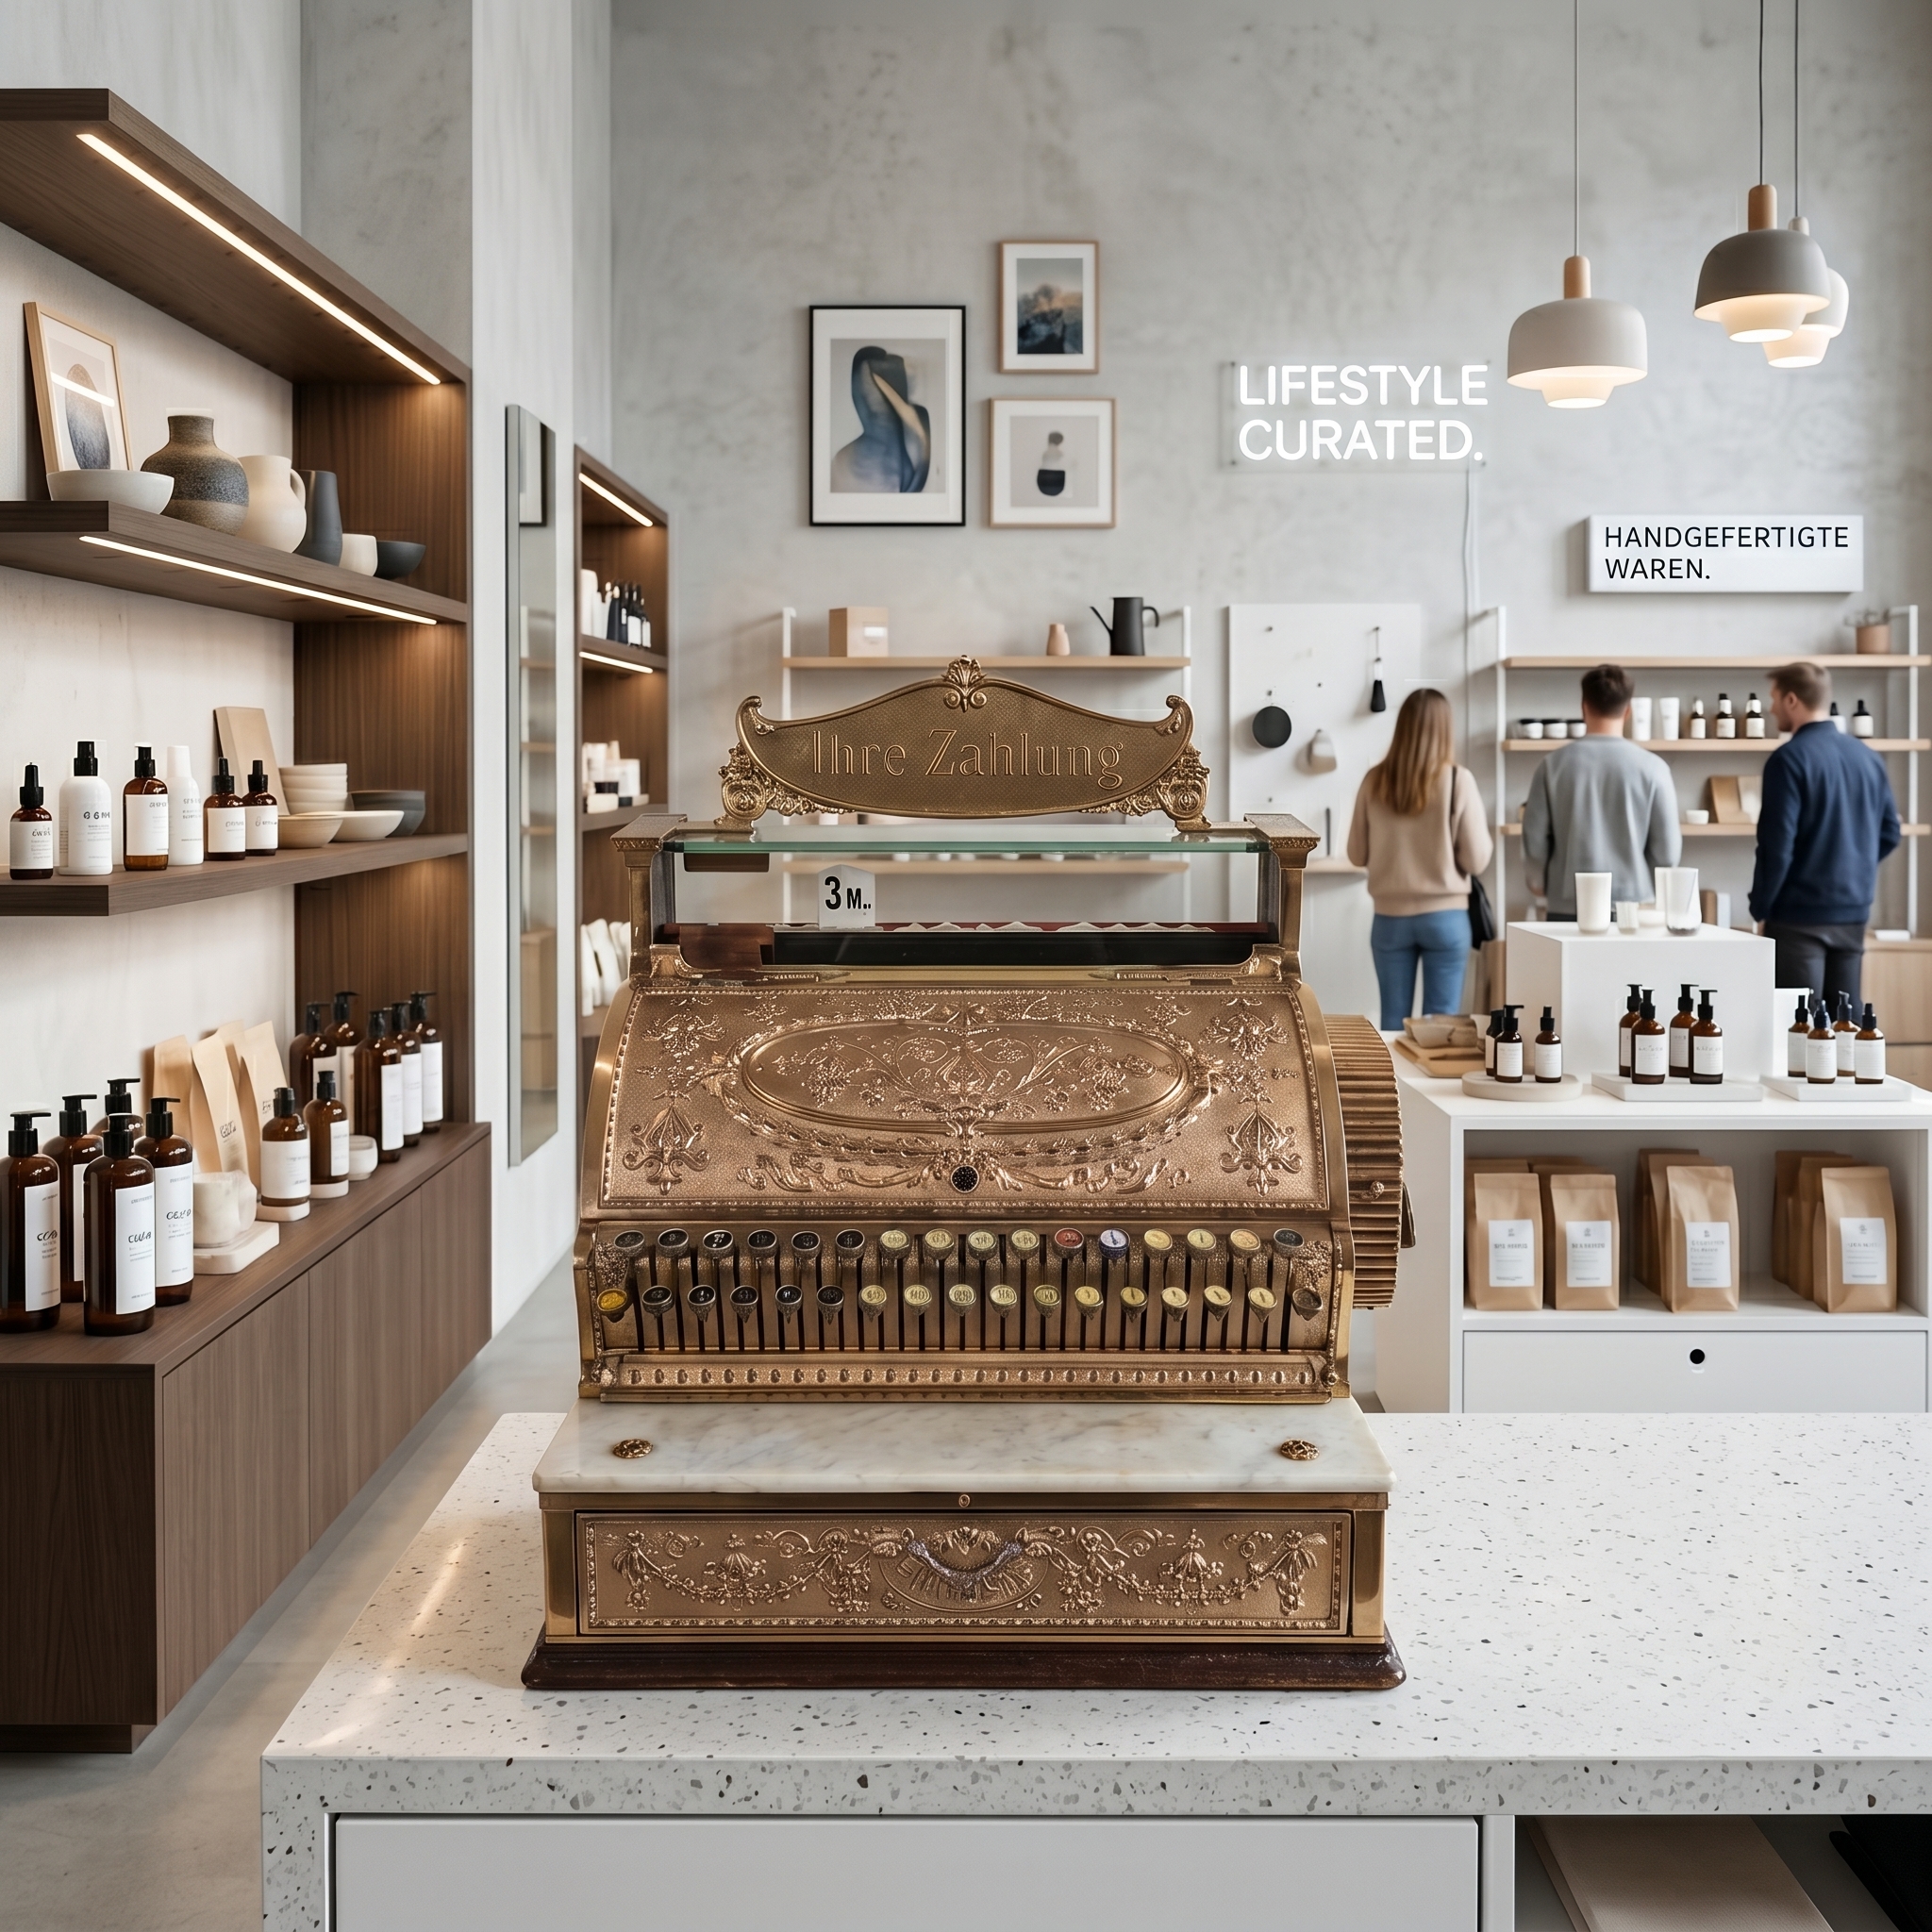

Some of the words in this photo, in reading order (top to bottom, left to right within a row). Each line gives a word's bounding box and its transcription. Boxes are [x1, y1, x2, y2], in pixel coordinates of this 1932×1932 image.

[1240, 364, 1489, 406] LIFESTYLE
[1239, 419, 1484, 461] CURATED.
[1605, 526, 1849, 548] HANDGEFERTIGTE
[1605, 558, 1710, 580] WAREN.
[812, 729, 906, 776] Ihre
[925, 728, 1124, 790] Zahlung
[824, 875, 841, 909] 3
